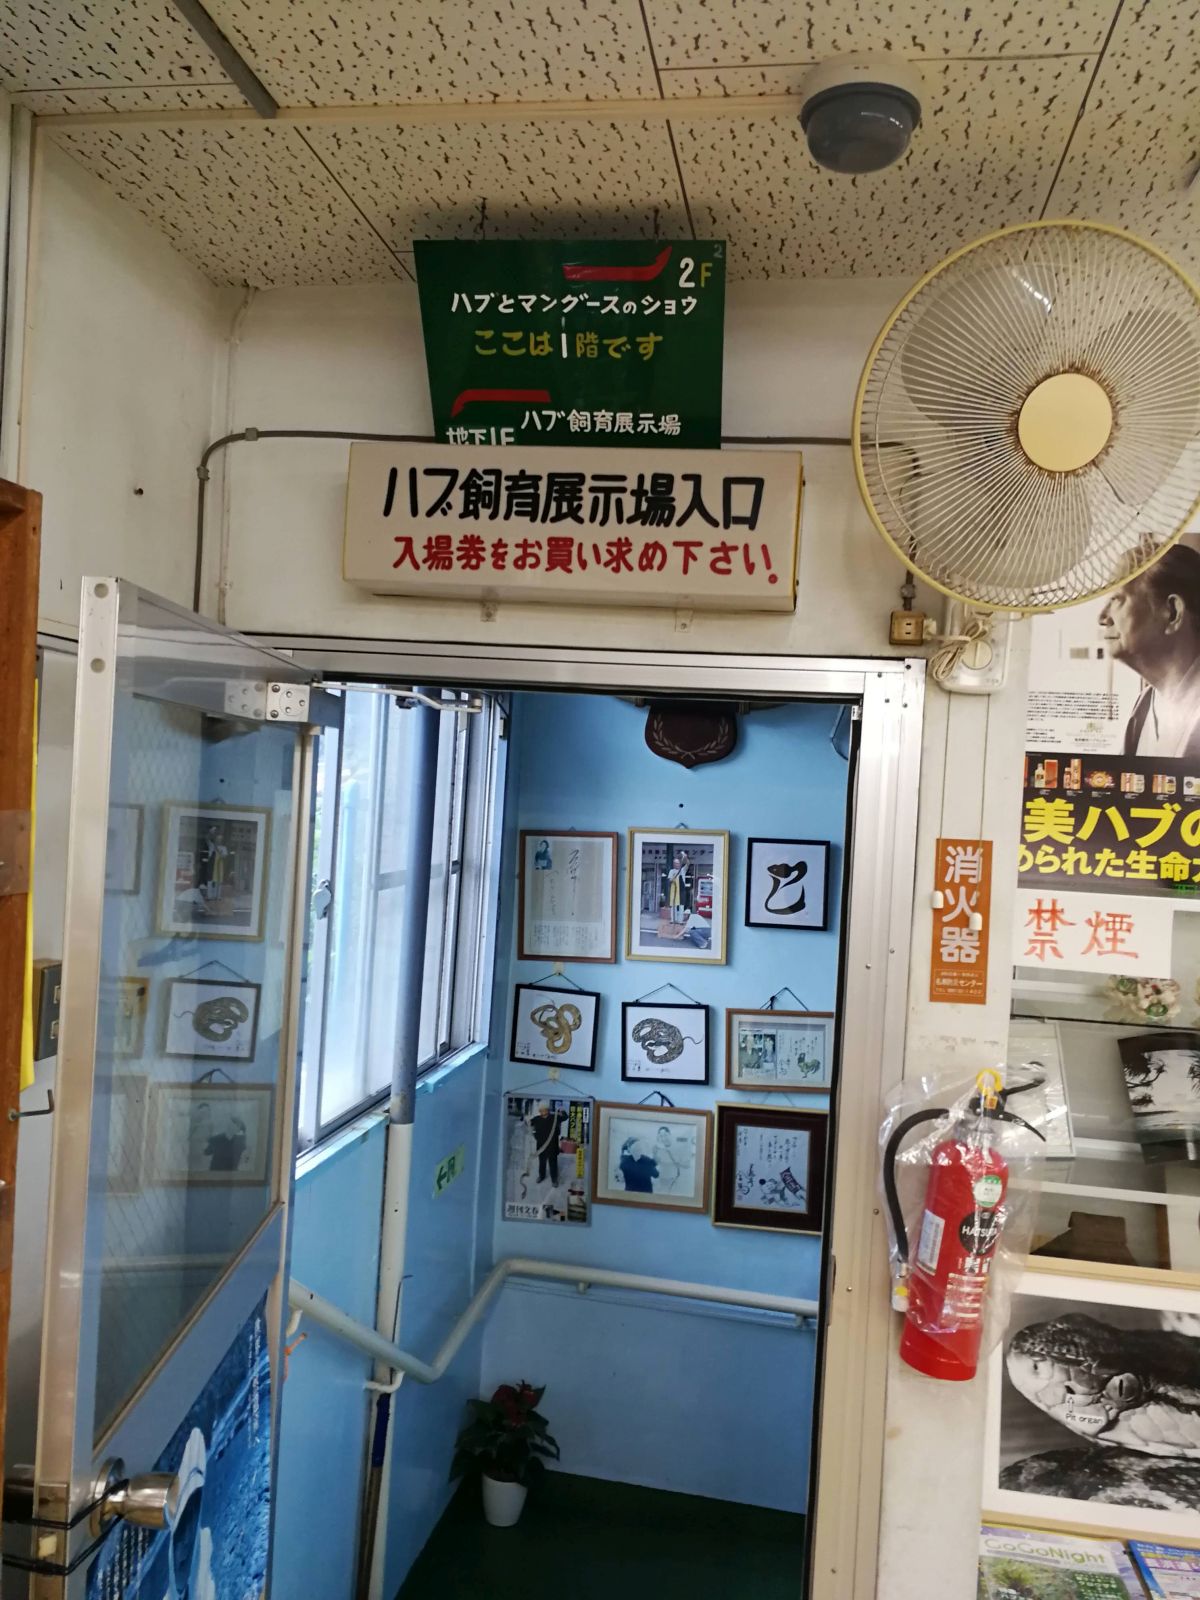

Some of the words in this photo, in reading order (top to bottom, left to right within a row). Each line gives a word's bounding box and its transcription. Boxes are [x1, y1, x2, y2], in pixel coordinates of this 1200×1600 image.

[679, 257, 713, 288] 2F
[451, 293, 698, 317] ハブとマングースのショウ
[520, 408, 682, 436] ハブ飼育展示場
[382, 466, 766, 531] ハブ飼育展示場入口
[1017, 843, 1200, 883] められた生命
[939, 845, 984, 964] 消火器
[1023, 897, 1140, 962] 禁煙
